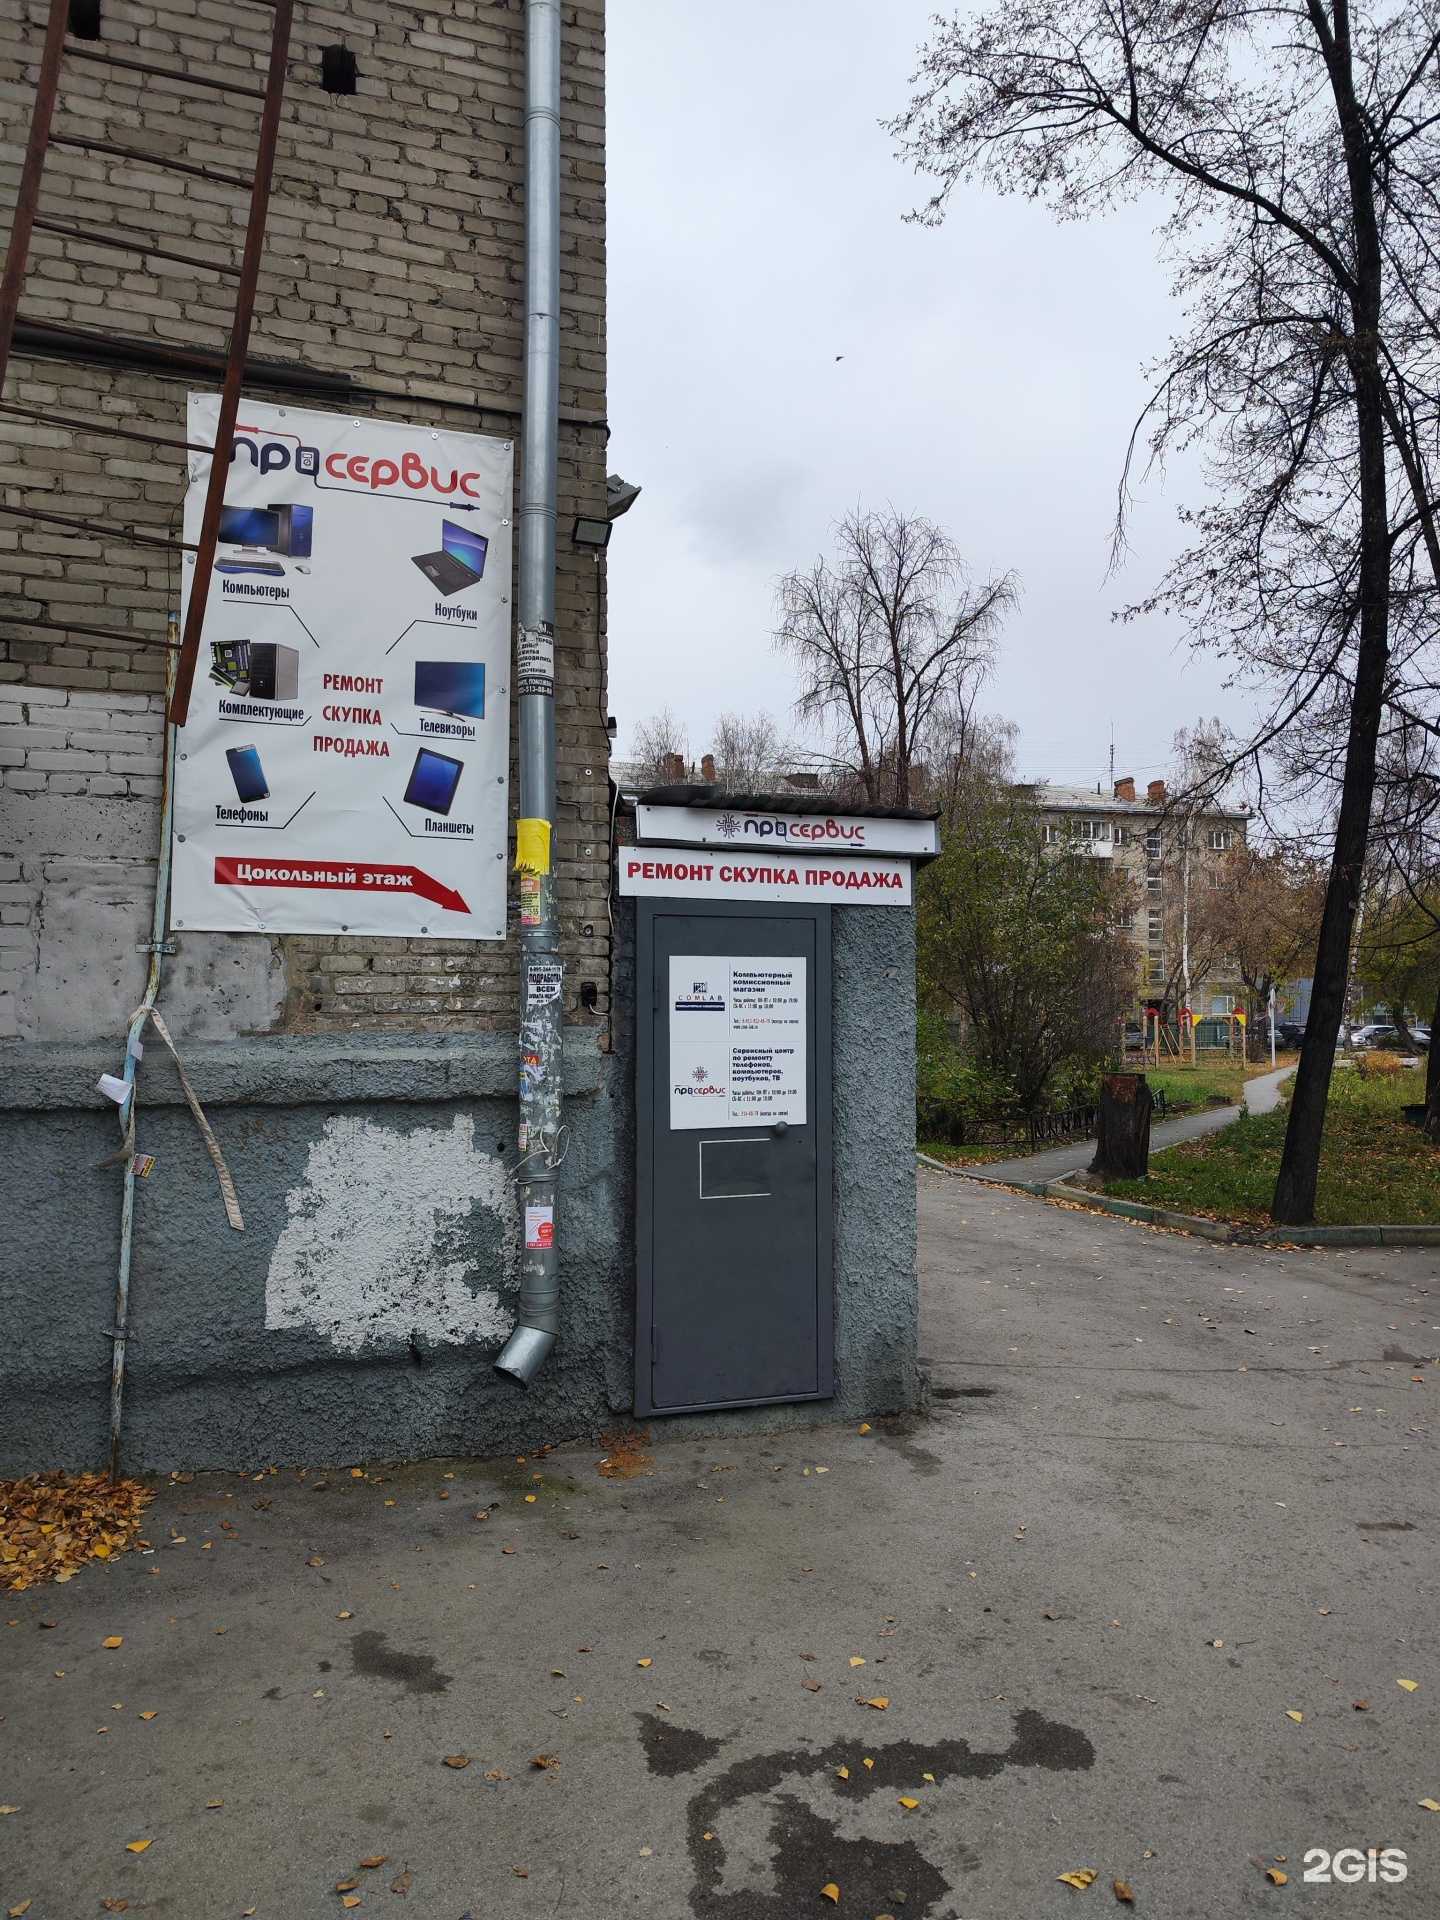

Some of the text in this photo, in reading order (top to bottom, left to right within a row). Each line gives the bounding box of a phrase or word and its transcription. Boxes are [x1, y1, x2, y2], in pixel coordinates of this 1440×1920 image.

[222, 579, 290, 600] Компьютеры
[435, 602, 478, 622] Ноутбуки
[323, 673, 384, 694] РЕМОНТ
[218, 699, 304, 721] Комплектующие
[322, 705, 382, 726] СКУПКА
[419, 718, 476, 738] Телевизоры
[313, 735, 390, 758] ПРОДАЖА
[215, 804, 269, 824] Телефоны
[424, 818, 474, 836] Планшеты
[237, 862, 413, 887] Цокольный этаж
[627, 862, 903, 890] РЕМОНТ СКУПКА ПРОДАЖА
[733, 971, 793, 979] Компьютерный
[732, 1047, 772, 1055] Сервисный
